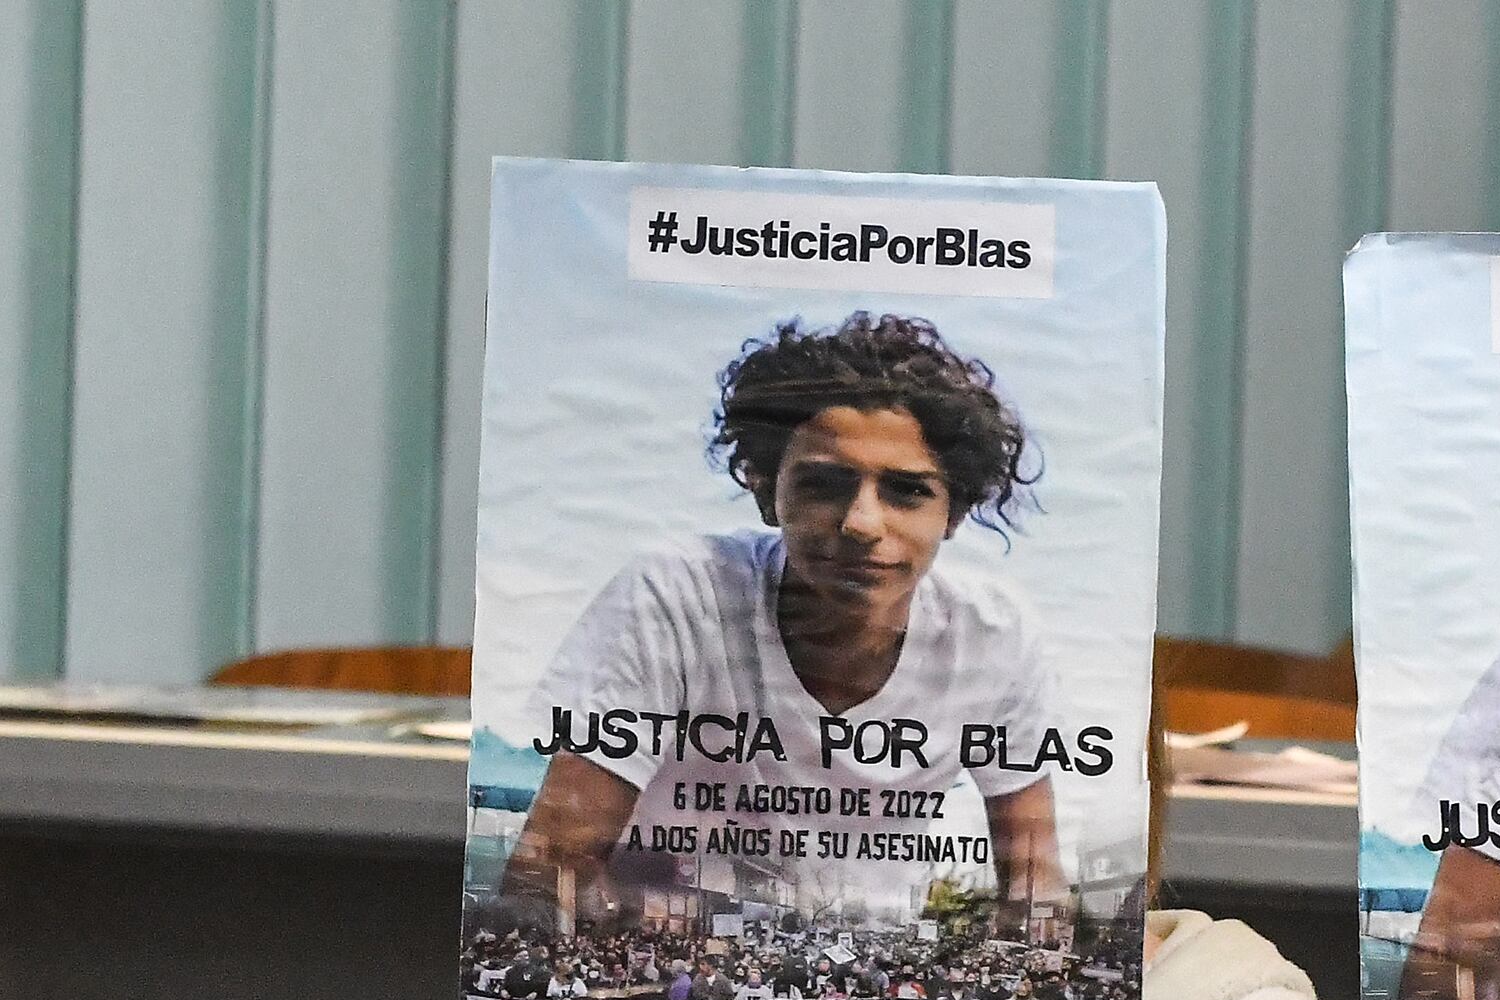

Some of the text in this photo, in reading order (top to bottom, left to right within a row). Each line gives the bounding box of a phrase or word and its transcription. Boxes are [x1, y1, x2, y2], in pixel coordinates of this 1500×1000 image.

[649, 212, 1031, 271] #JusticiaPorBlas
[533, 706, 1114, 777] JUSTICIA POR BLAS
[674, 783, 946, 820] 6 DE AGOSTO DE 2022
[627, 819, 988, 865] A DOS AÑOS DE SU ASESINATO
